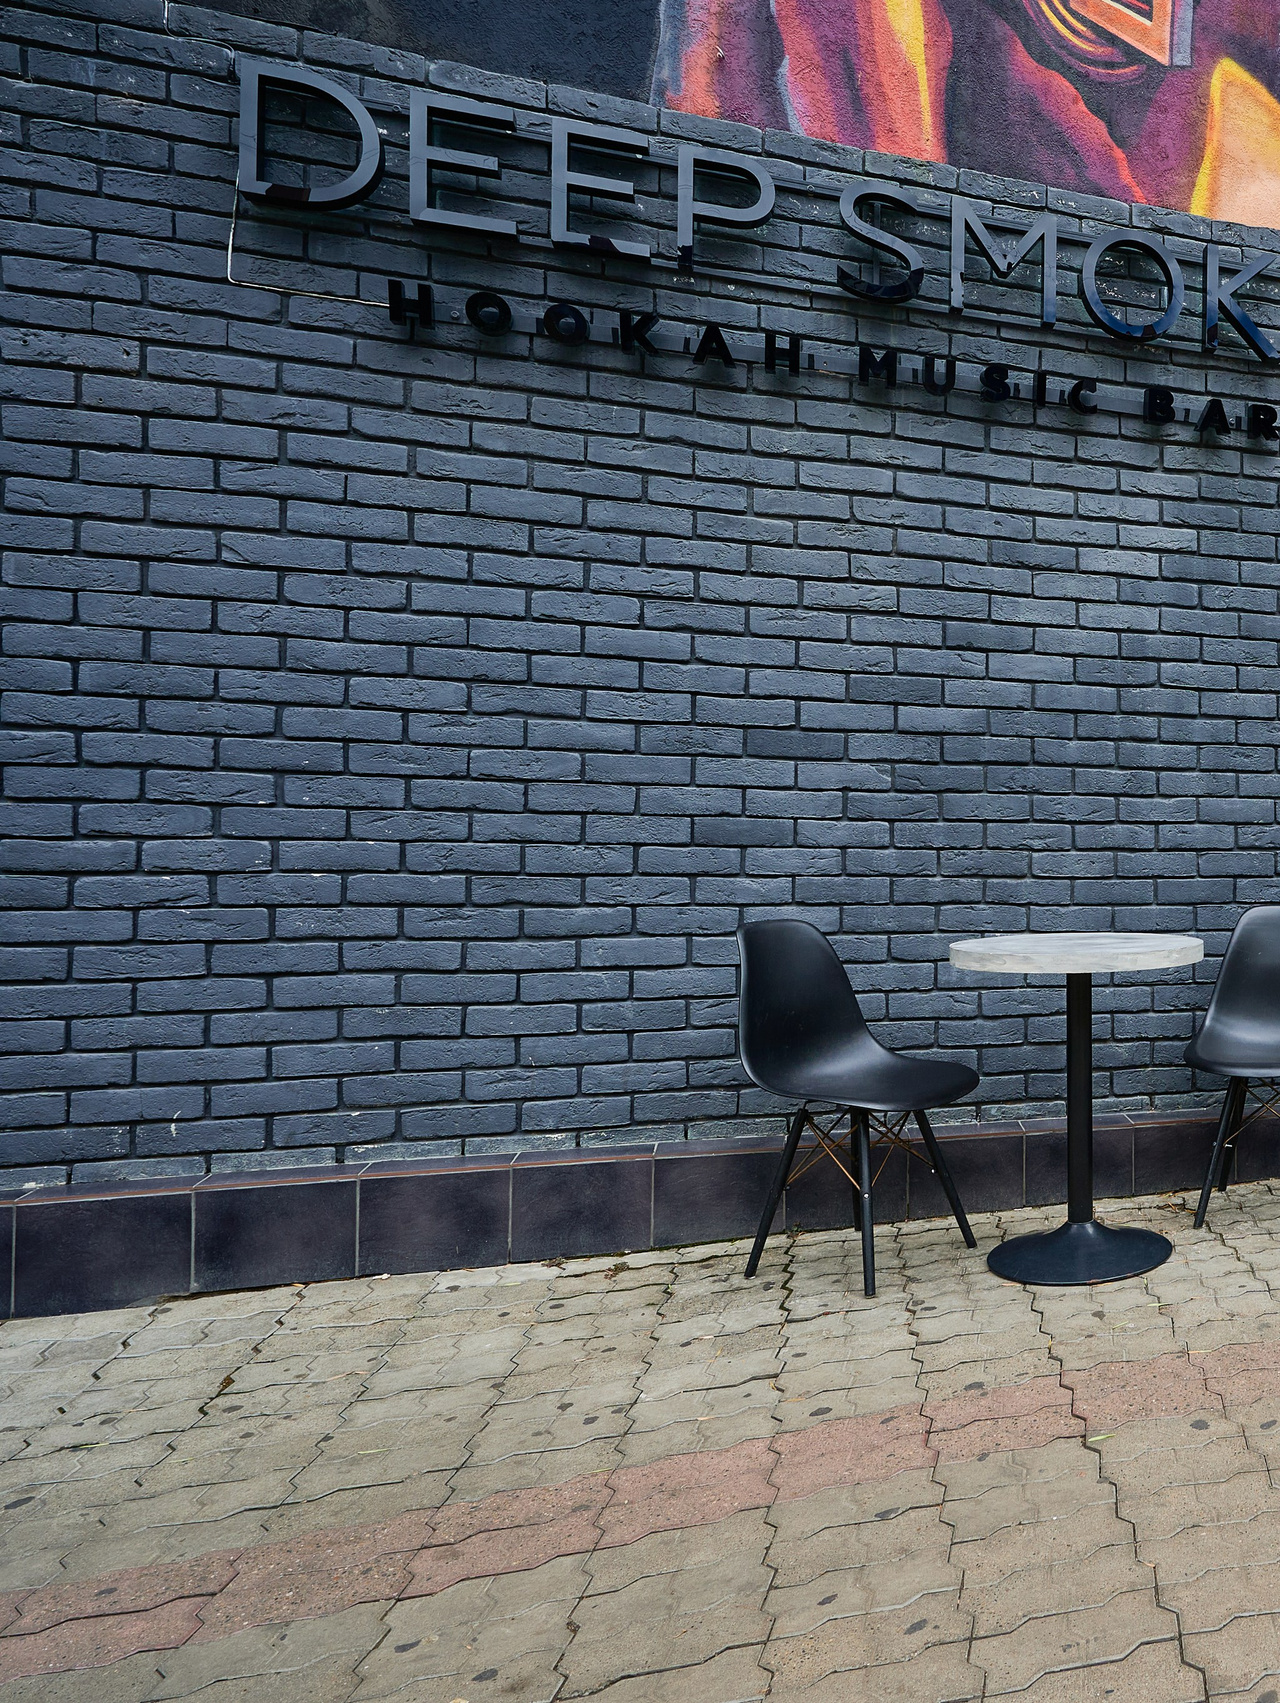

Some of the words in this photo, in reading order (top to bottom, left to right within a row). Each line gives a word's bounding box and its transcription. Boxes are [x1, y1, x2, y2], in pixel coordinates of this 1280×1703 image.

[237, 56, 776, 271] DEEP
[388, 279, 801, 378] HOOKAH
[858, 347, 1098, 414] MUSIC
[1143, 387, 1280, 441] BAR
